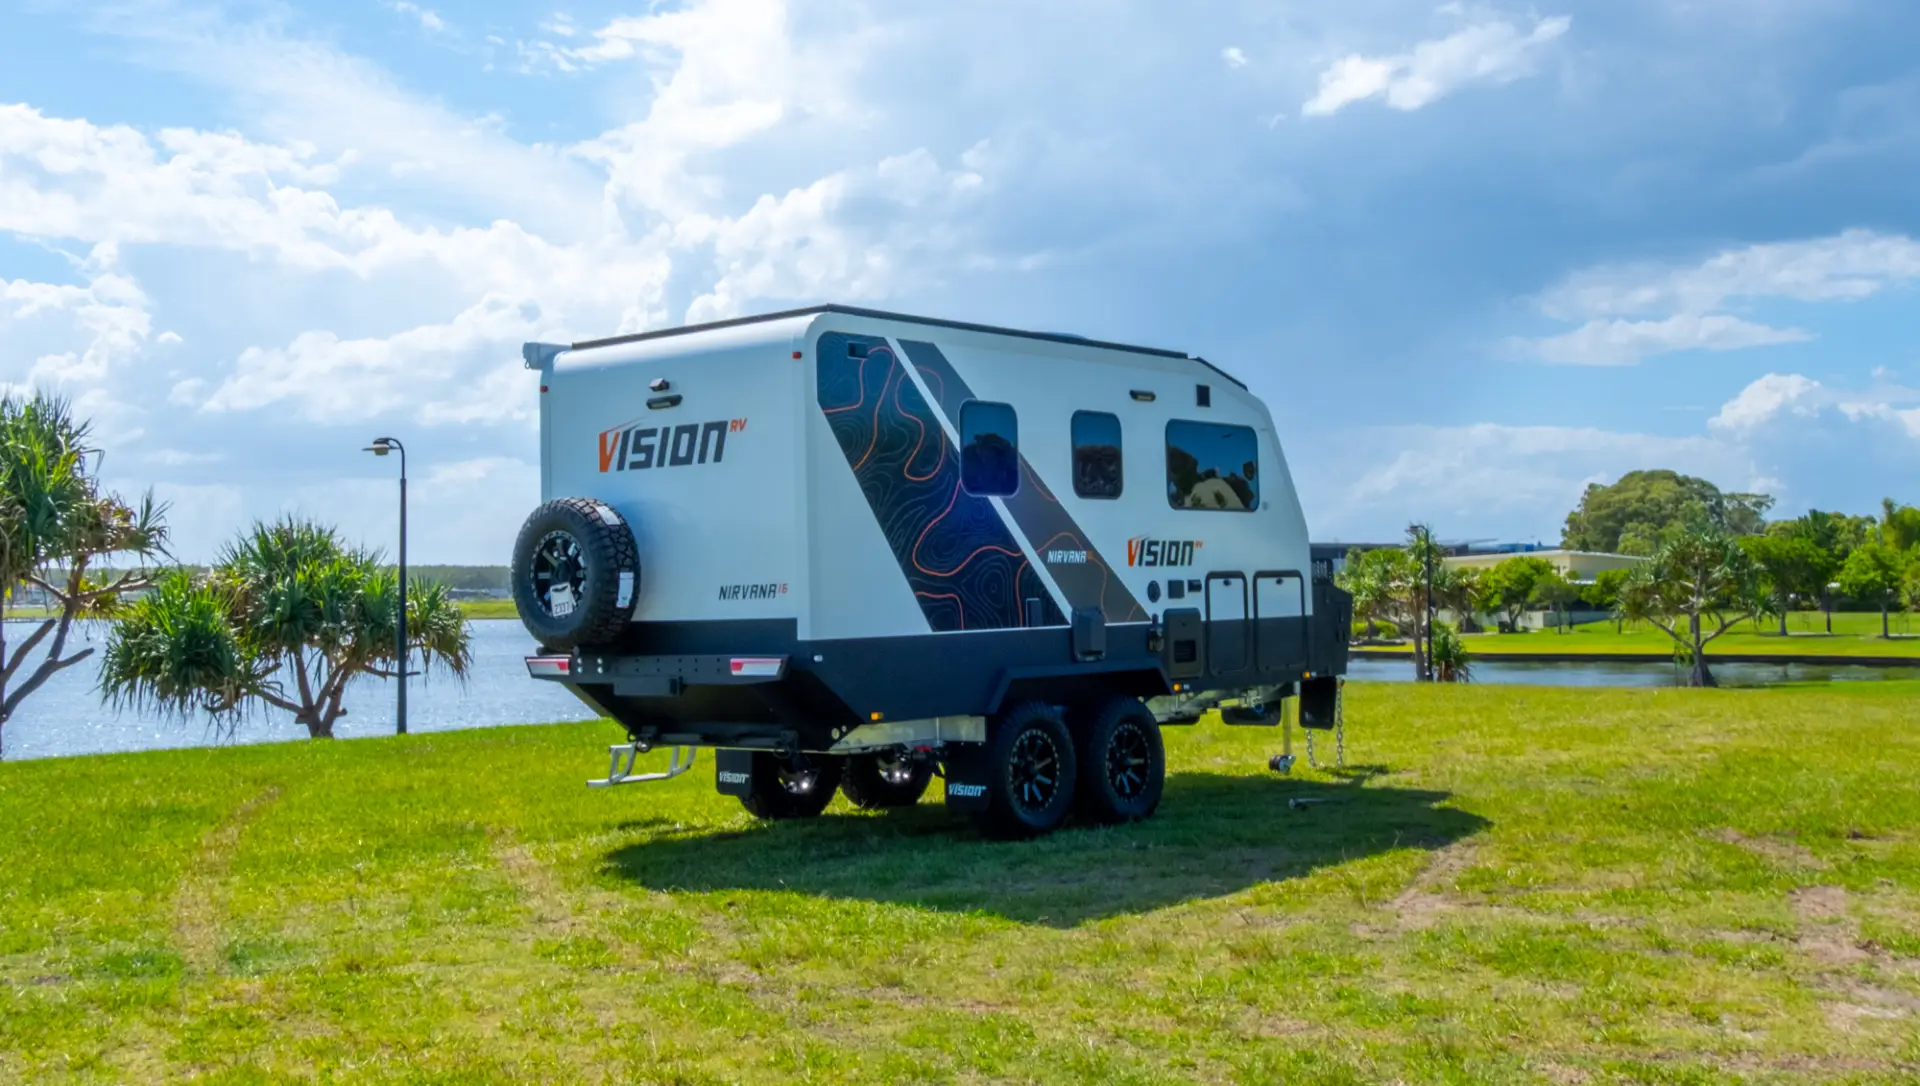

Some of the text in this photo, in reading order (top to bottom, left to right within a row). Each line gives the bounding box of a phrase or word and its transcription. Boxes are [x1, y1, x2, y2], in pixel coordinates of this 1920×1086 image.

[598, 417, 748, 473] VISION RV
[1047, 550, 1087, 564] NIRVANA
[1127, 538, 1194, 567] VISION
[718, 583, 777, 600] NIRVANA
[948, 783, 982, 797] VISION
